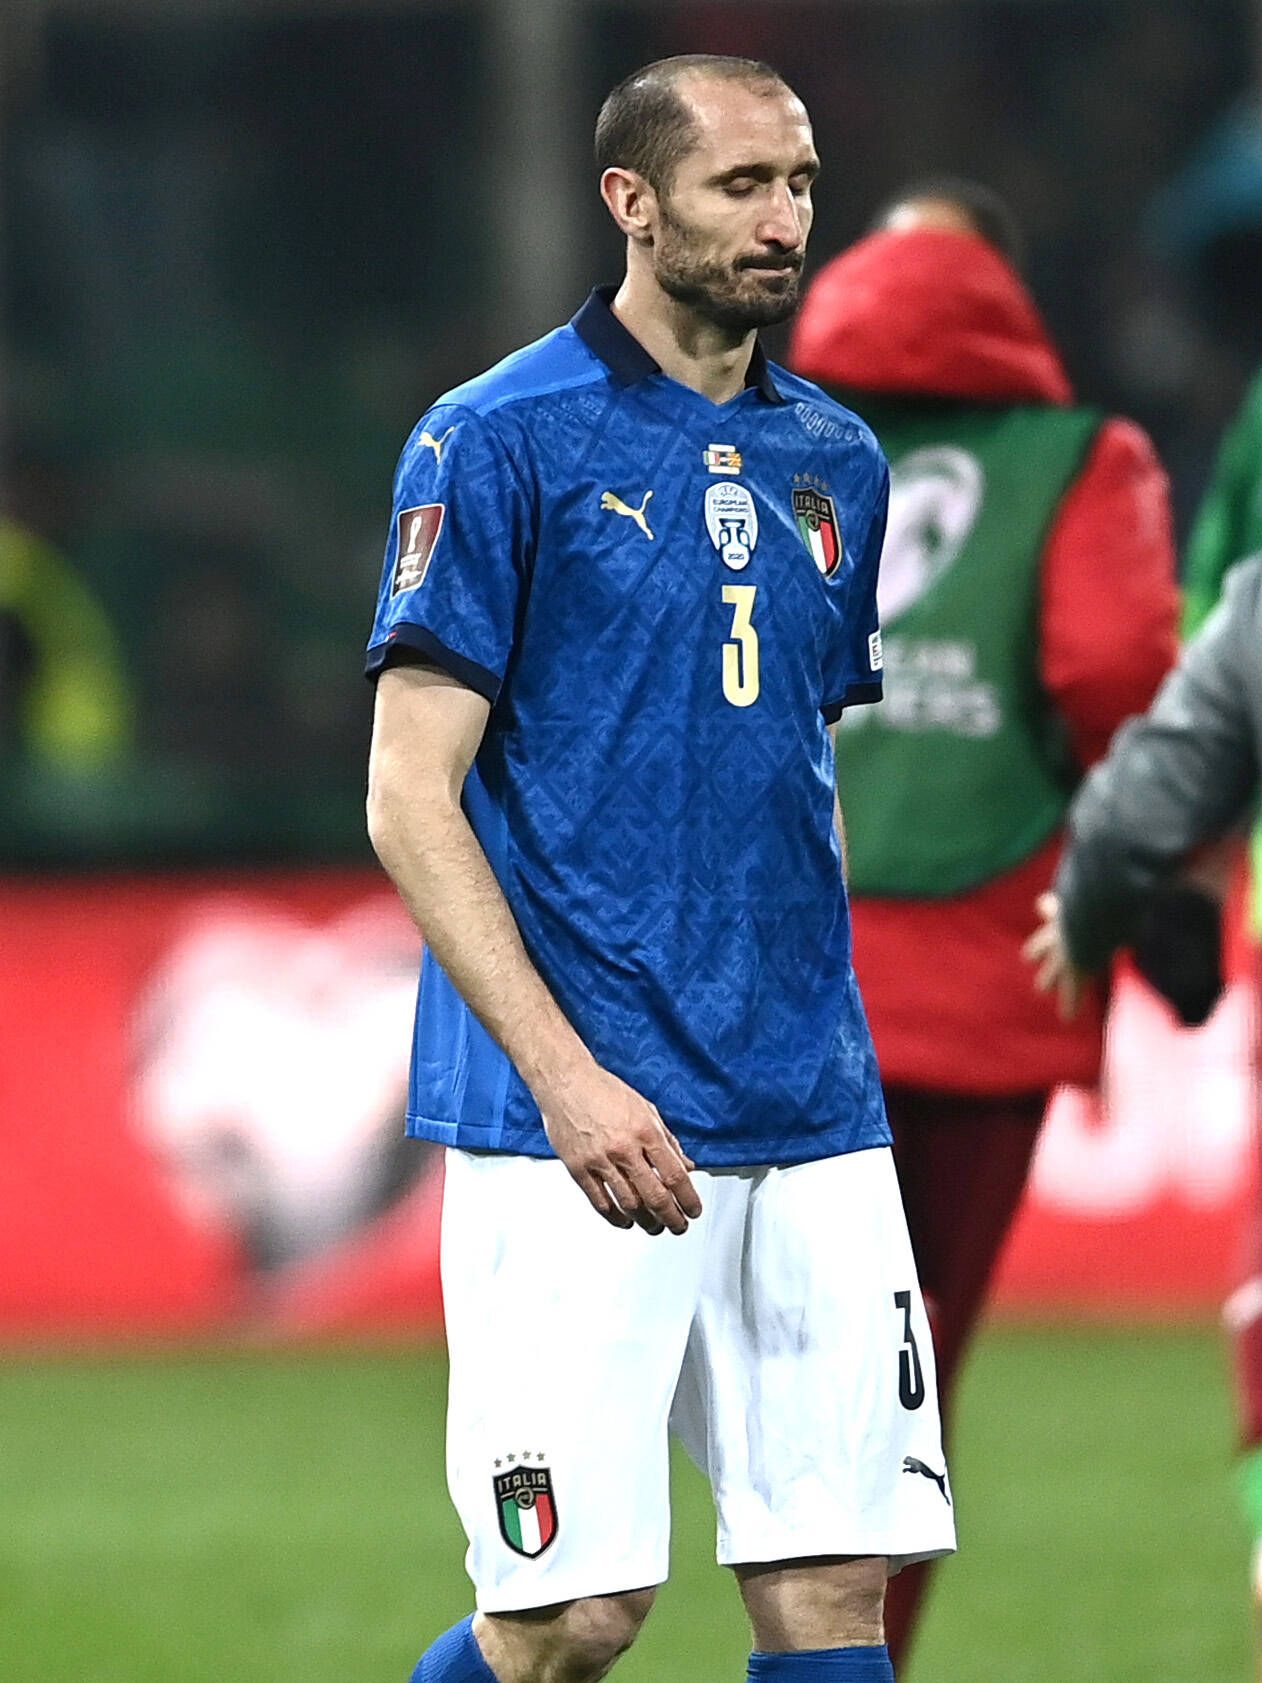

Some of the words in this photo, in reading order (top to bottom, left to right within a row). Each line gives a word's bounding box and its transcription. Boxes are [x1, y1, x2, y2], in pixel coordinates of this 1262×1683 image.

[712, 498, 748, 506] EUROPEAN
[795, 495, 829, 514] ITALIA
[721, 585, 760, 707] 3
[893, 1290, 925, 1411] 3
[497, 1472, 547, 1494] ITALIA
